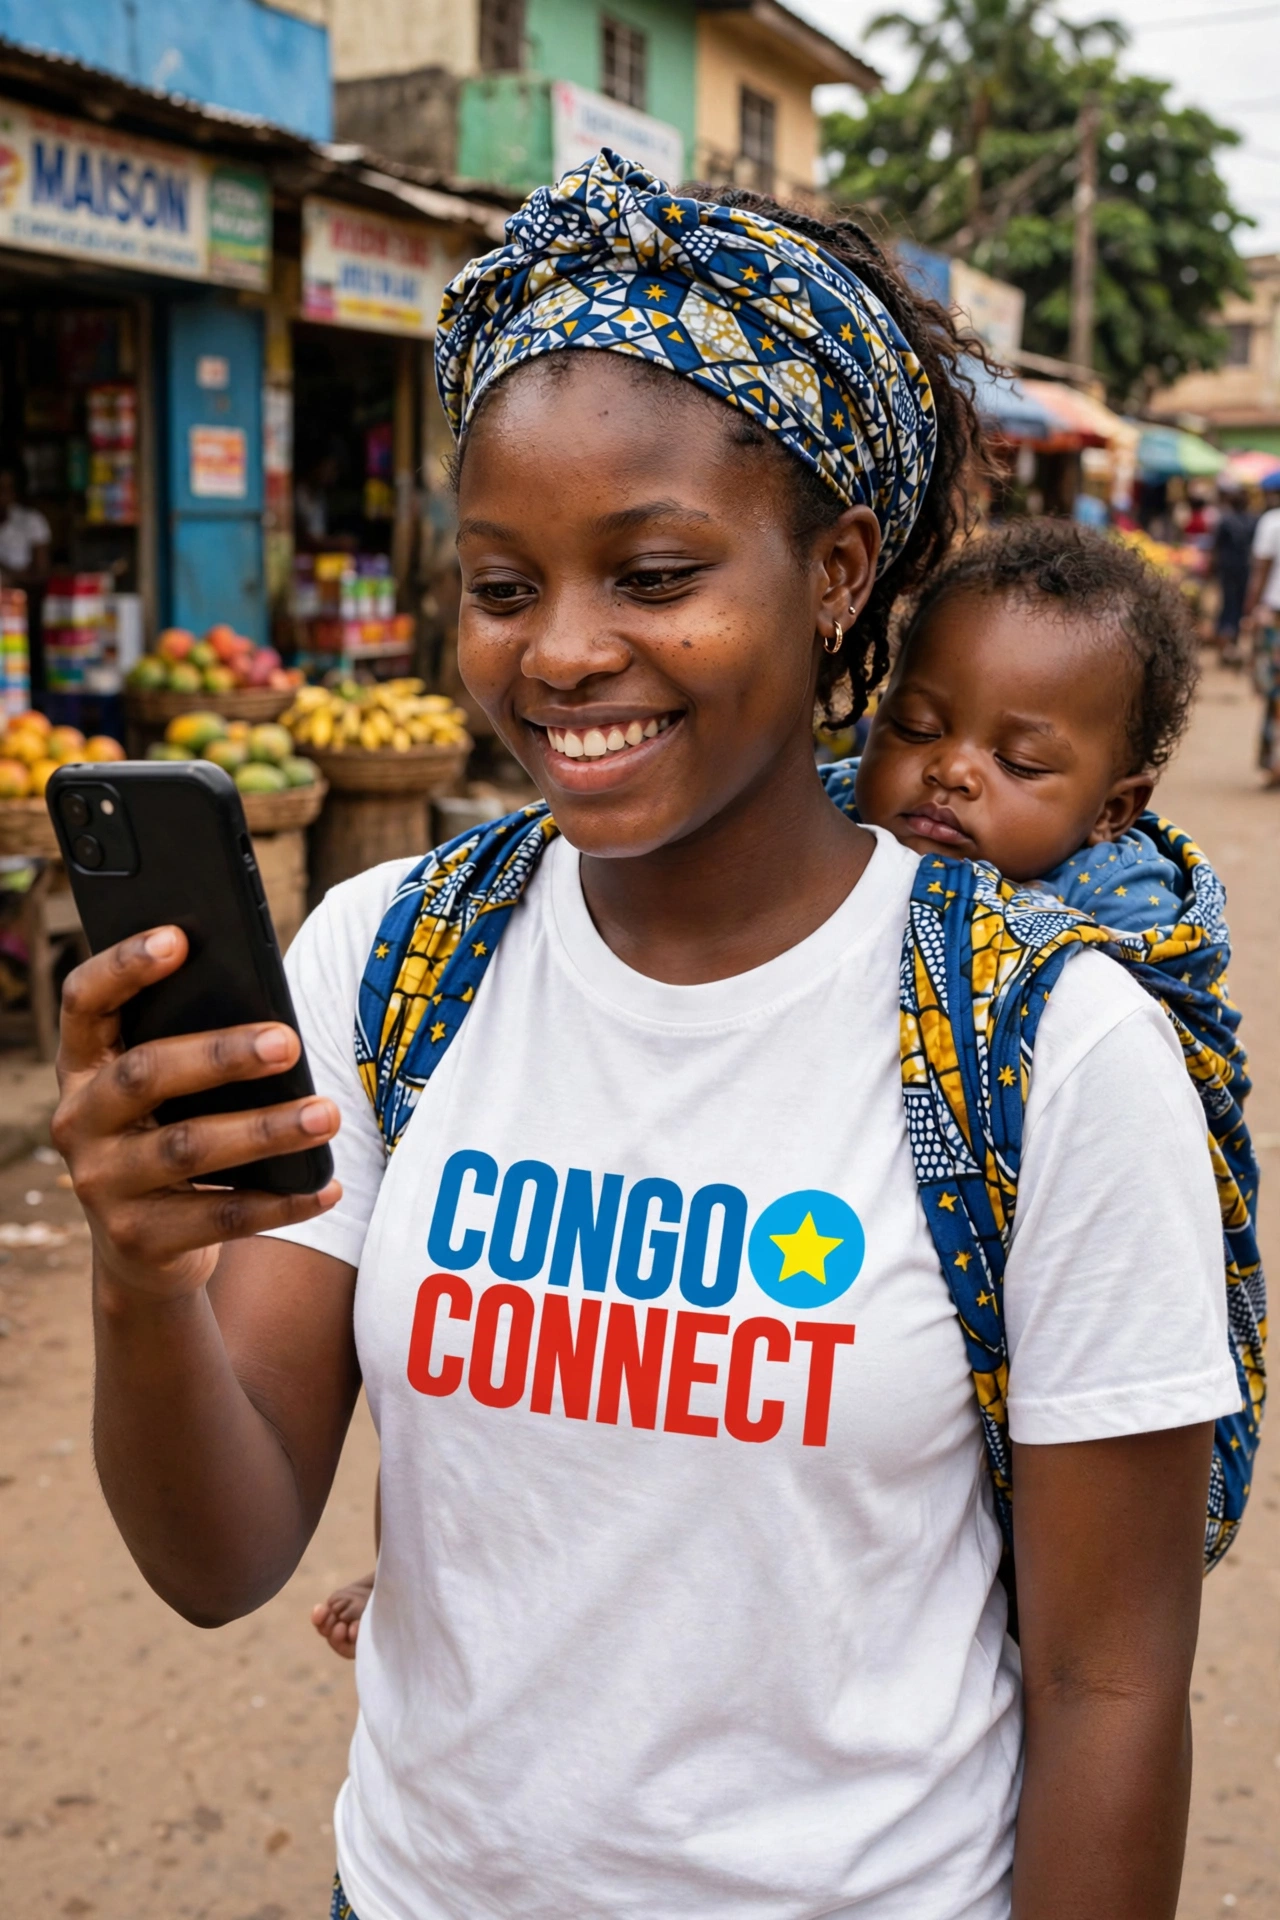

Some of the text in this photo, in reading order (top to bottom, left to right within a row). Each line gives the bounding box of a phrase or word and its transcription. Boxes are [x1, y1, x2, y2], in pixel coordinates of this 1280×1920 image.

[31, 138, 189, 234] MAISON
[427, 1149, 748, 1308] CONGO
[407, 1273, 855, 1447] CONNECT
